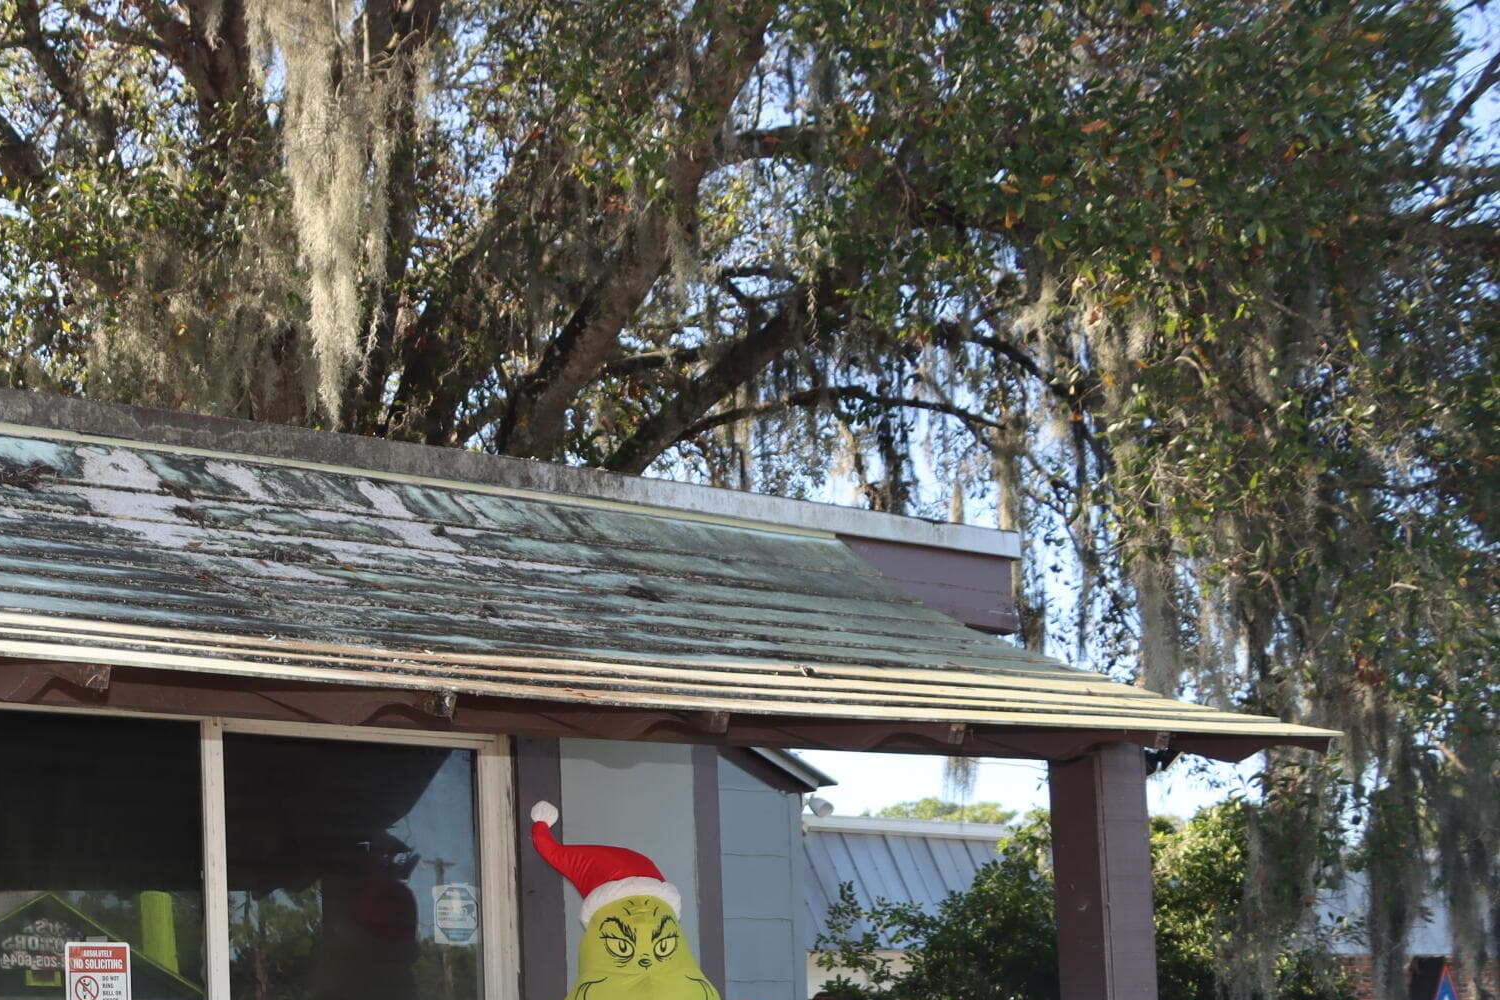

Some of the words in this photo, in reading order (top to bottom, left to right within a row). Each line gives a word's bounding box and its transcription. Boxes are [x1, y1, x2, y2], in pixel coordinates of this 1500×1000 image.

[83, 950, 112, 958] ABSOLUTELY
[73, 959, 84, 969] NO
[85, 959, 123, 969] SOLICITING
